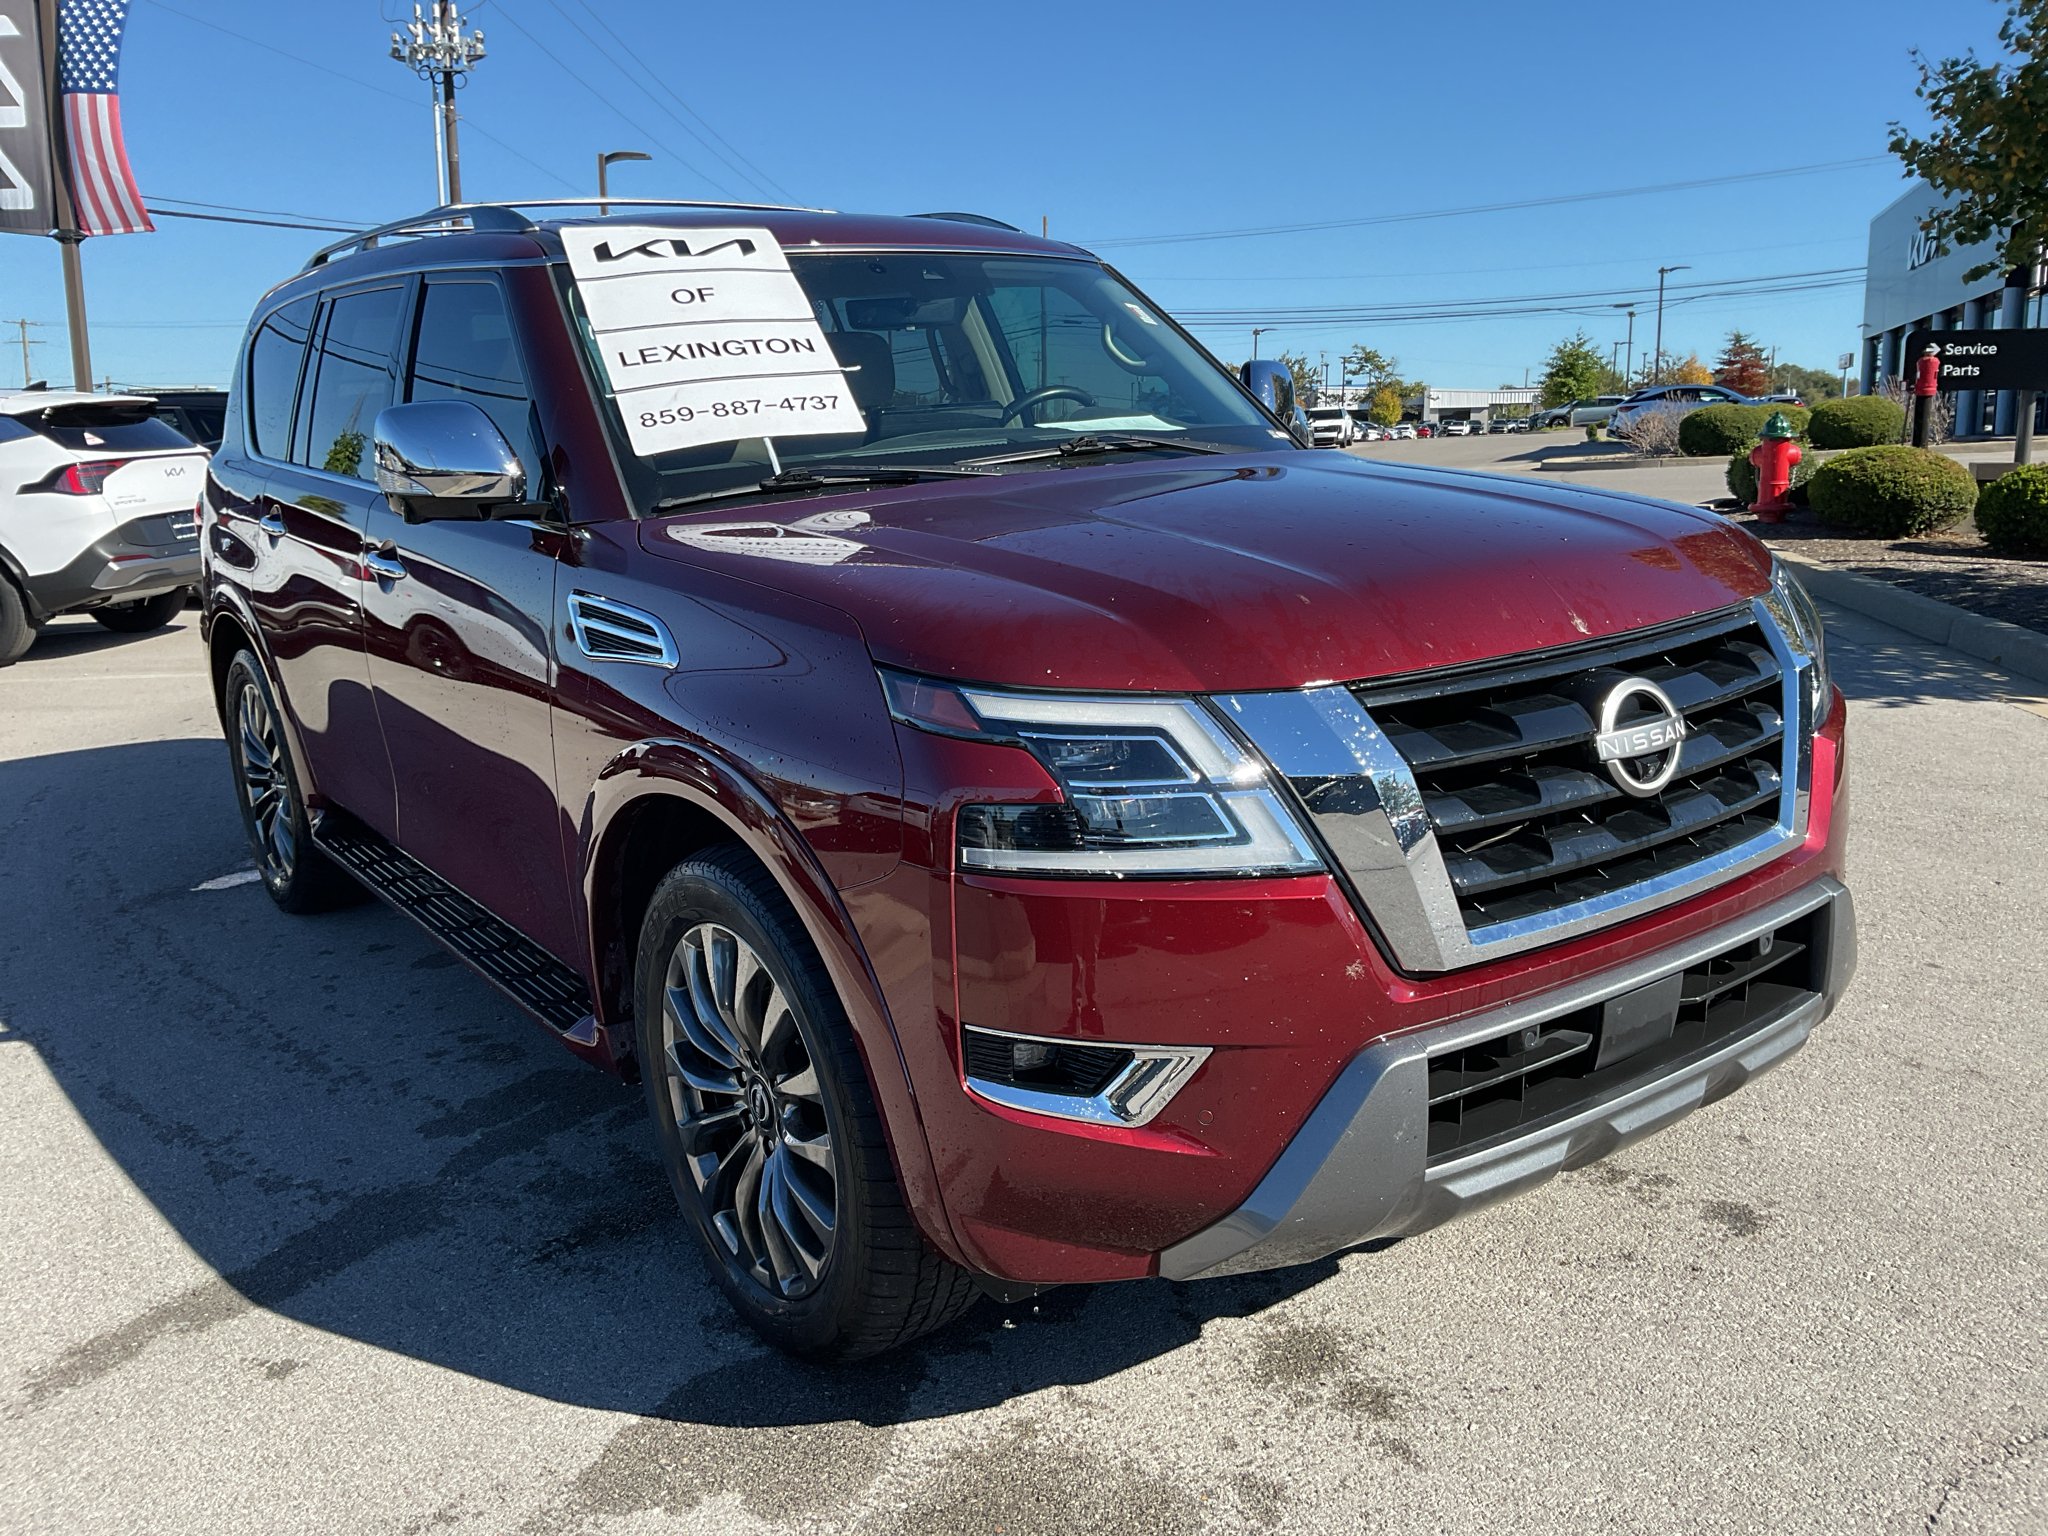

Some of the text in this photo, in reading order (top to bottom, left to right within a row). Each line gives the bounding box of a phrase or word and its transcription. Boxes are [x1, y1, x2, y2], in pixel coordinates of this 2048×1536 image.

[593, 238, 756, 263] KIA
[671, 287, 715, 304] OF
[618, 338, 816, 368] LEXINGTON
[1945, 343, 1998, 355] Service
[1943, 364, 1980, 376] Parts
[640, 395, 839, 428] 859-887-4737
[1600, 720, 1686, 757] NISSAN
